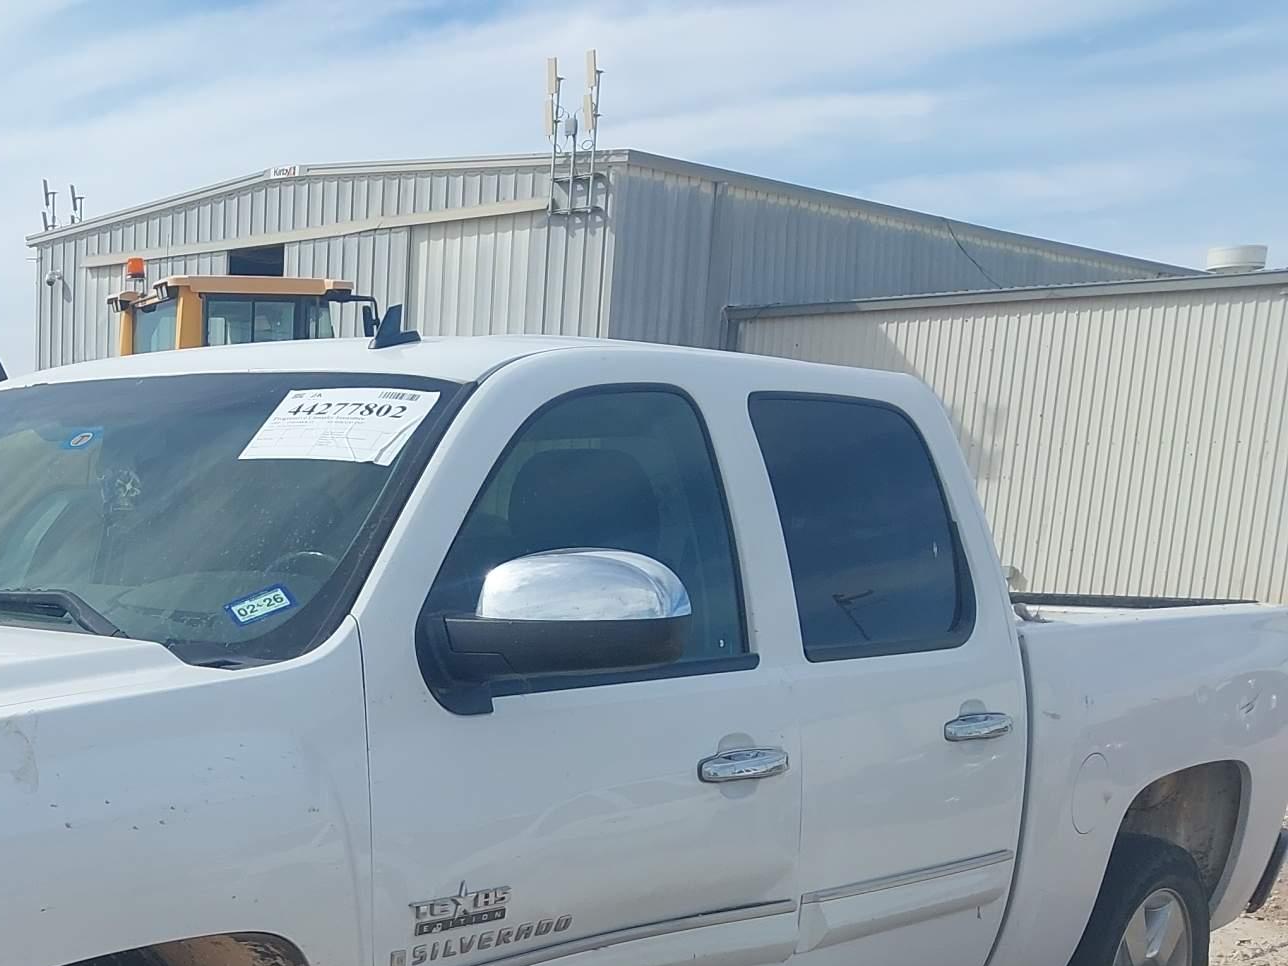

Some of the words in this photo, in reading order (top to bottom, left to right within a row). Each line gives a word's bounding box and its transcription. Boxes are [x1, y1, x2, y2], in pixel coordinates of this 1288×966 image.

[288, 402, 408, 419] 44277802
[408, 883, 513, 919] TEXAS
[423, 911, 502, 933] EDITION
[411, 914, 573, 966] SILVERADO
